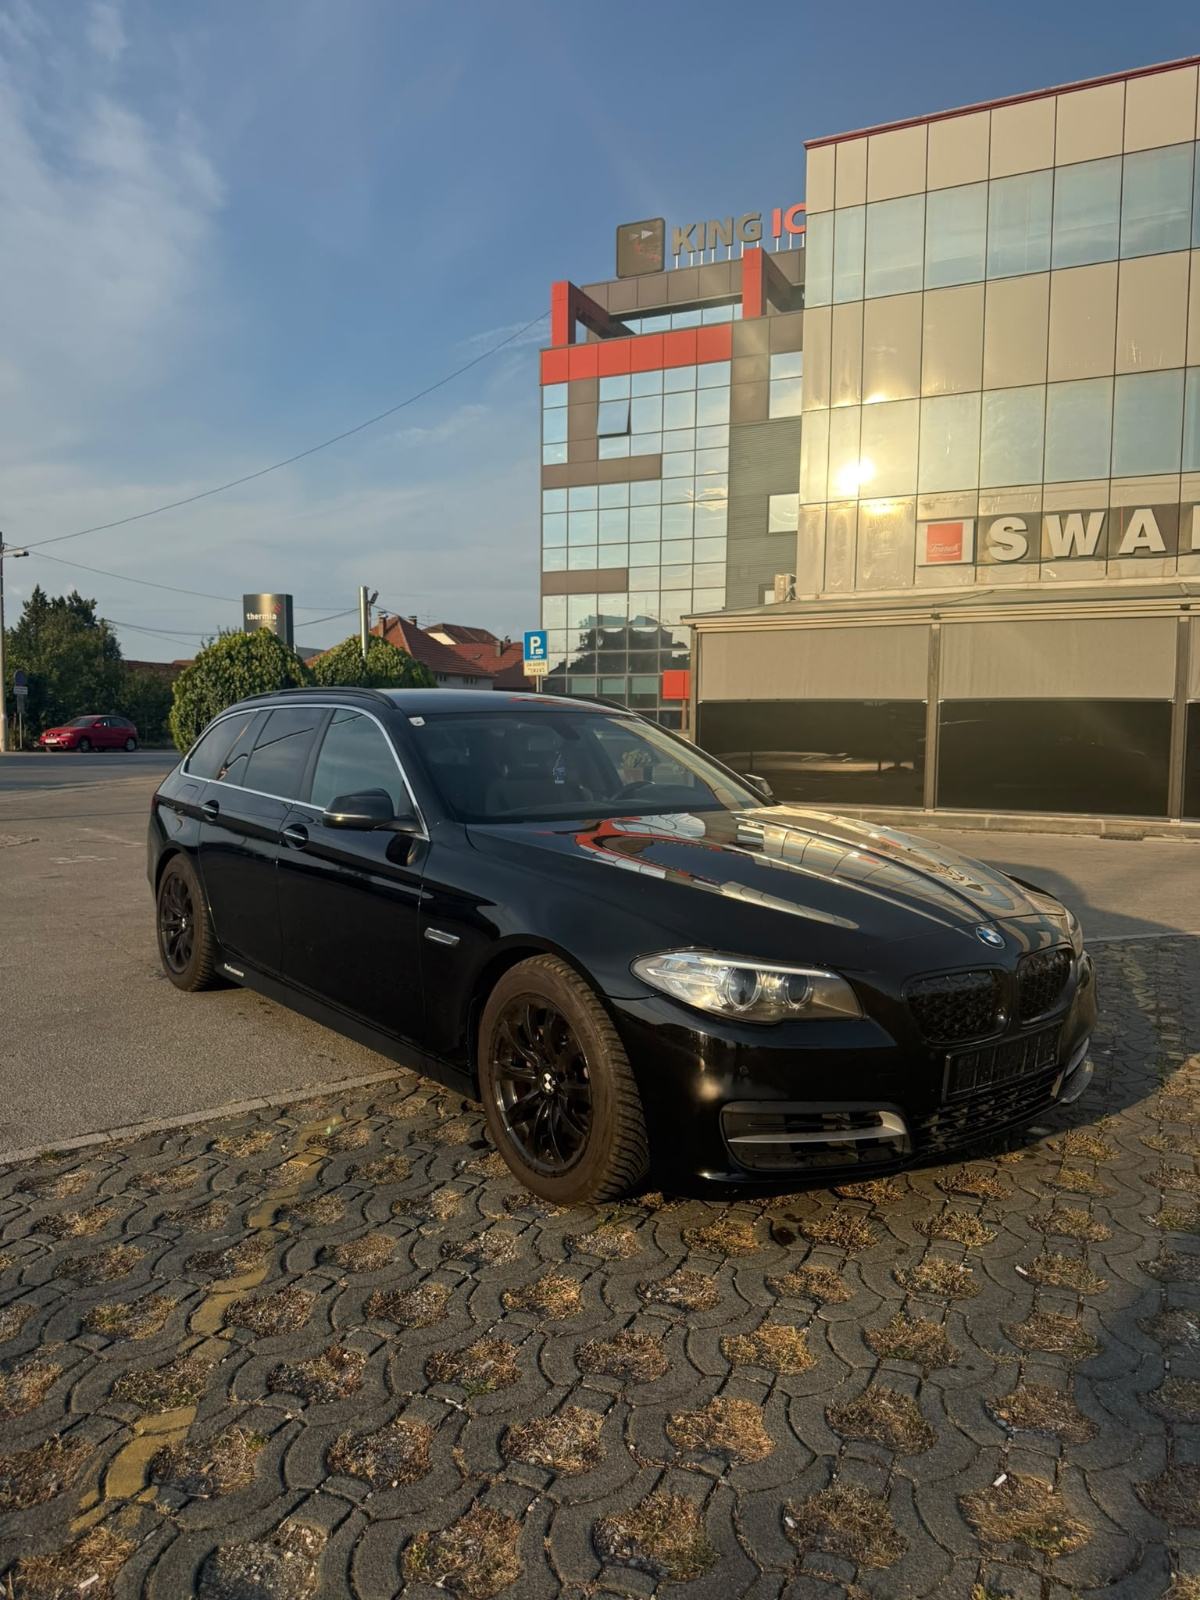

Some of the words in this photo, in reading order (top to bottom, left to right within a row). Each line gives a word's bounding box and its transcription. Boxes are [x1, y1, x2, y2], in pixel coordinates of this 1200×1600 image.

[672, 211, 762, 256] KING
[988, 505, 1200, 562] SWA
[246, 612, 277, 620] thermia
[530, 636, 541, 655] P
